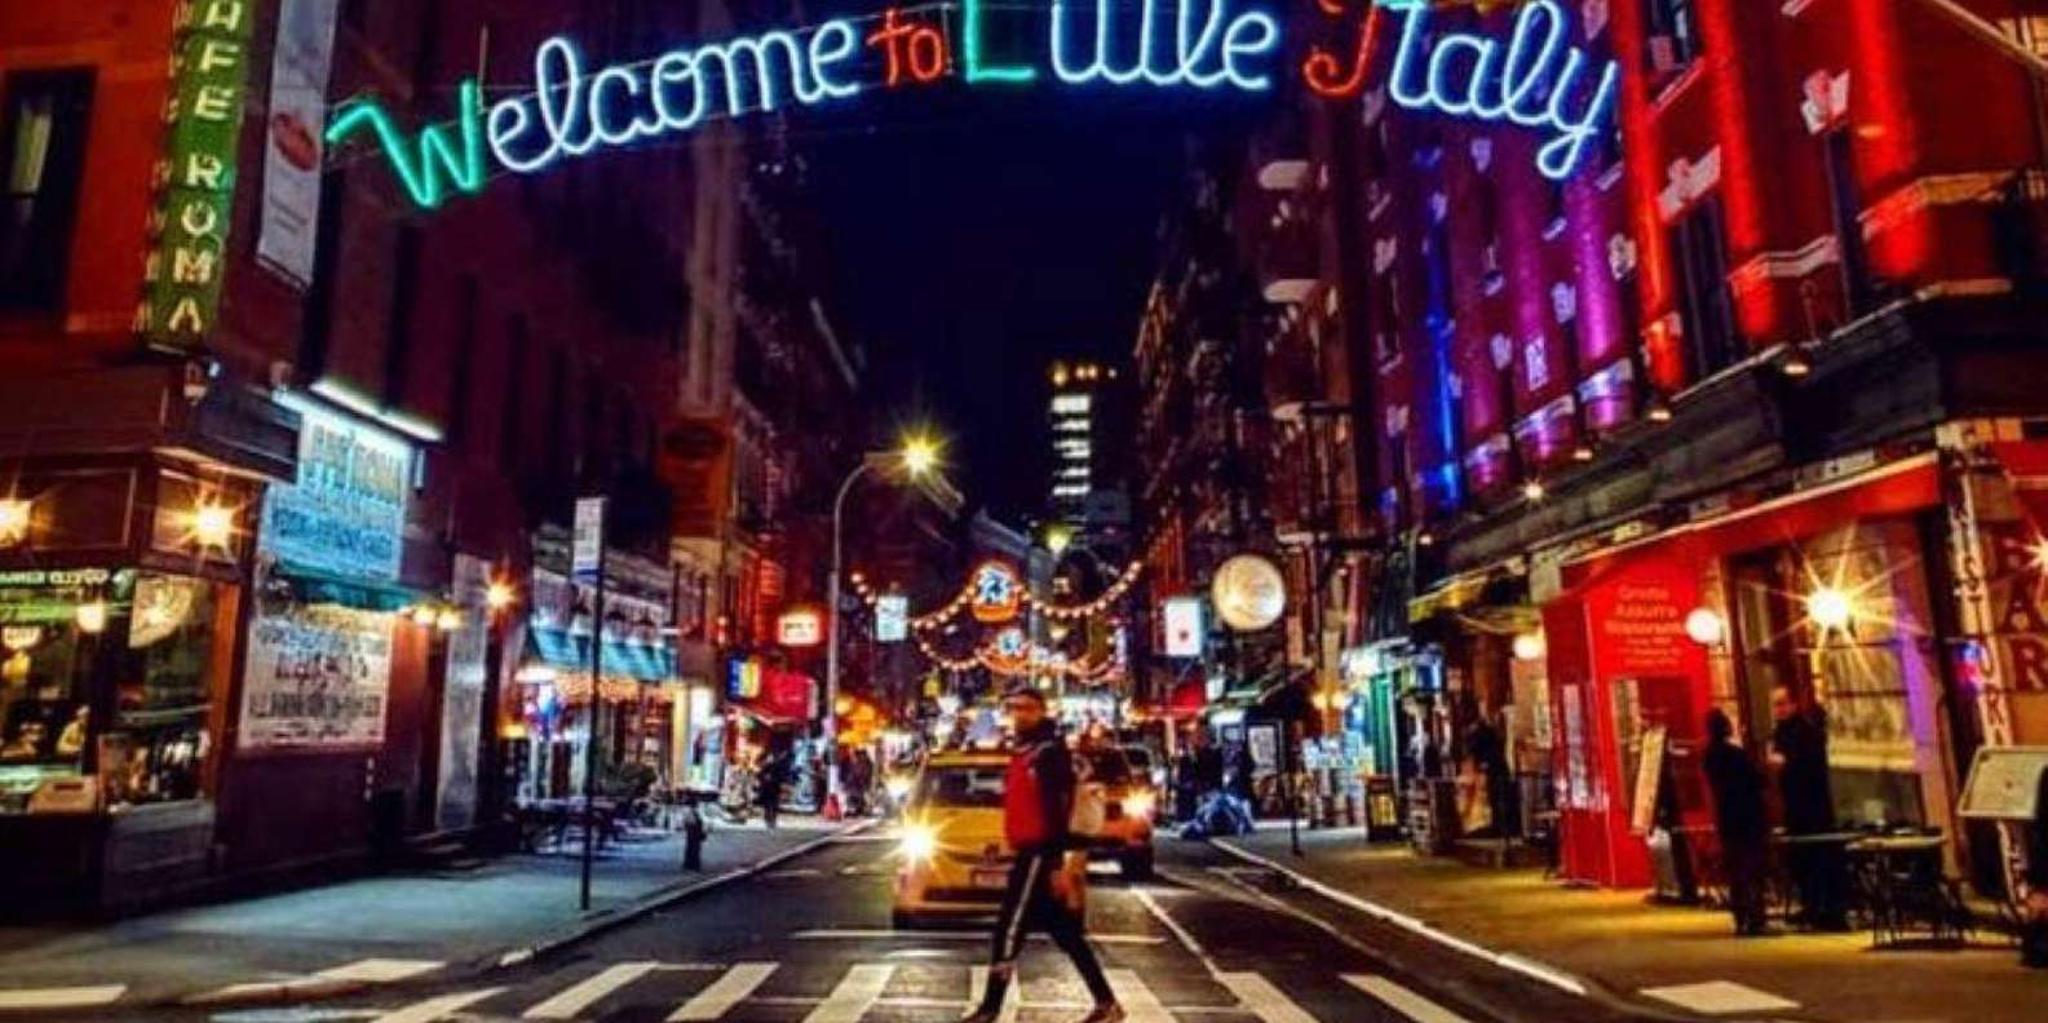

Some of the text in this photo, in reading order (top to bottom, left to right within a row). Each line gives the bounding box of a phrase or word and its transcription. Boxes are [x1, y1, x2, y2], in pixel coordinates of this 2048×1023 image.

[326, 20, 861, 207] Welcome
[866, 9, 946, 86] to
[965, 0, 1276, 88] Little
[1303, 0, 1619, 179] Italy
[167, 153, 223, 333] ROMA
